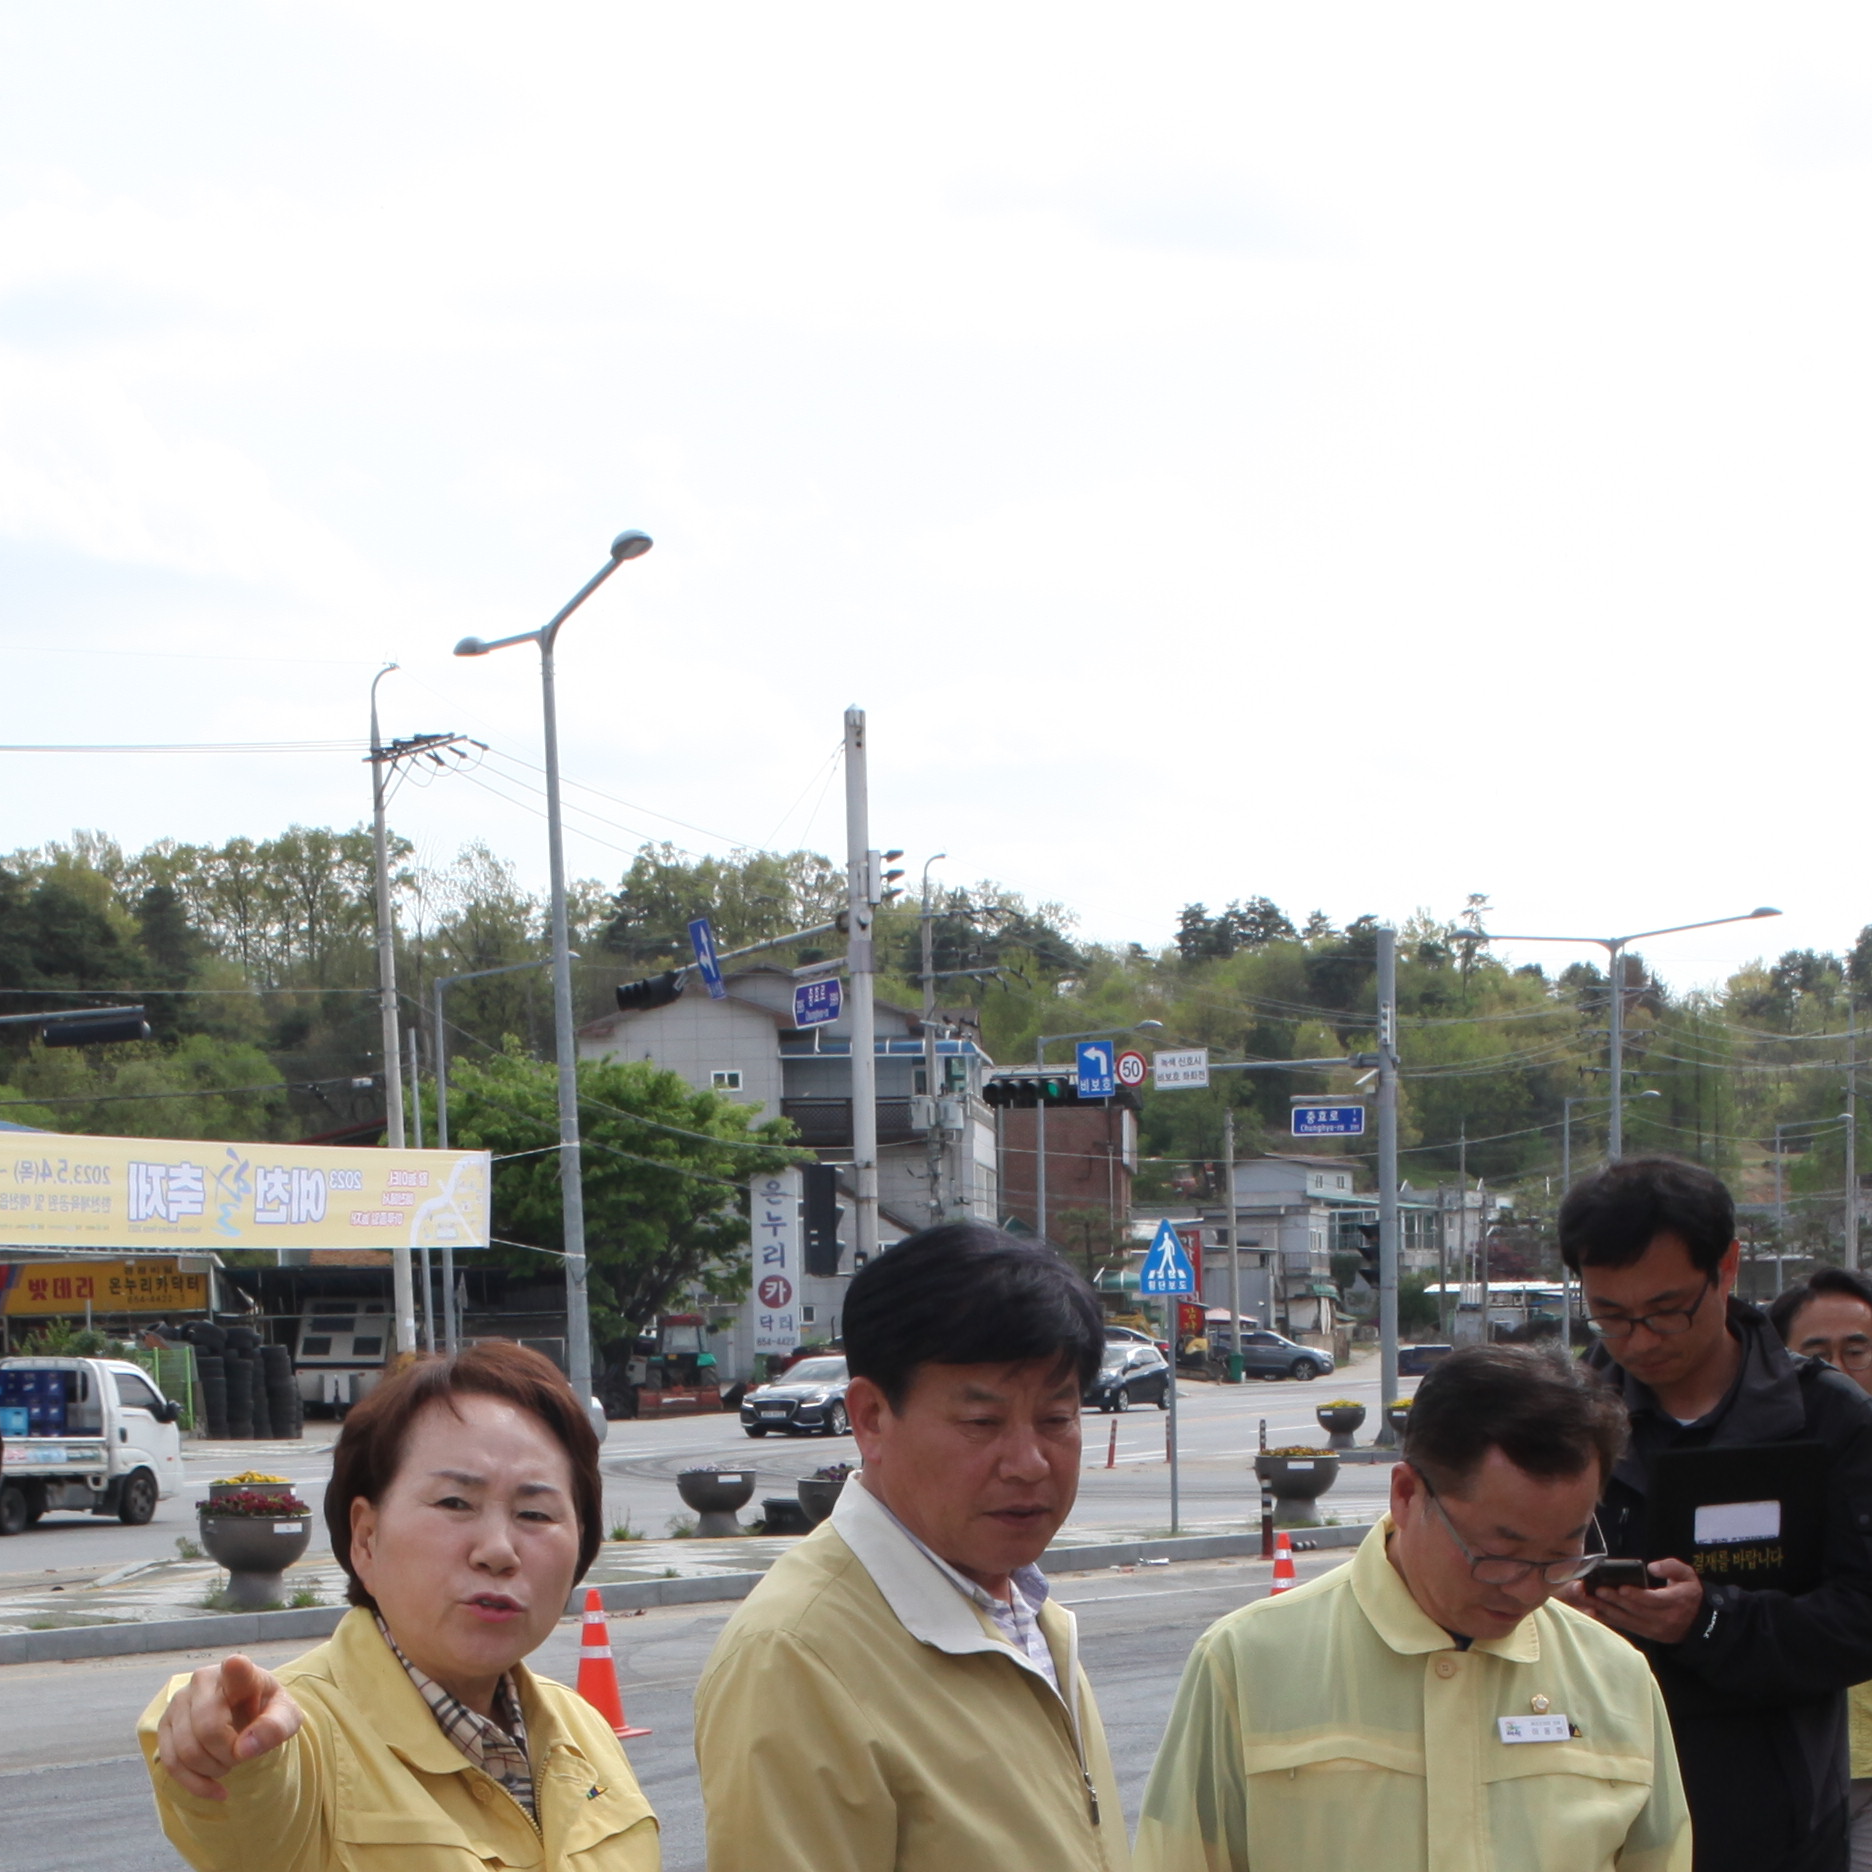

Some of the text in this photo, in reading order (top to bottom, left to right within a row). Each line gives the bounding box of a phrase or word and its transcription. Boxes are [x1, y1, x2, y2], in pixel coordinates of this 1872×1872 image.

[1122, 1060, 1141, 1078] 50
[1080, 1077, 1112, 1093] 비보호
[1306, 1110, 1340, 1125] 충효로
[28, 1276, 95, 1301] 밧데리
[108, 1275, 200, 1296] 온누리카닥터
[1148, 1280, 1188, 1291] 횡단보도
[756, 1336, 796, 1347] 654-4422
[1693, 1547, 1784, 1574] 결재를 바랍니다
